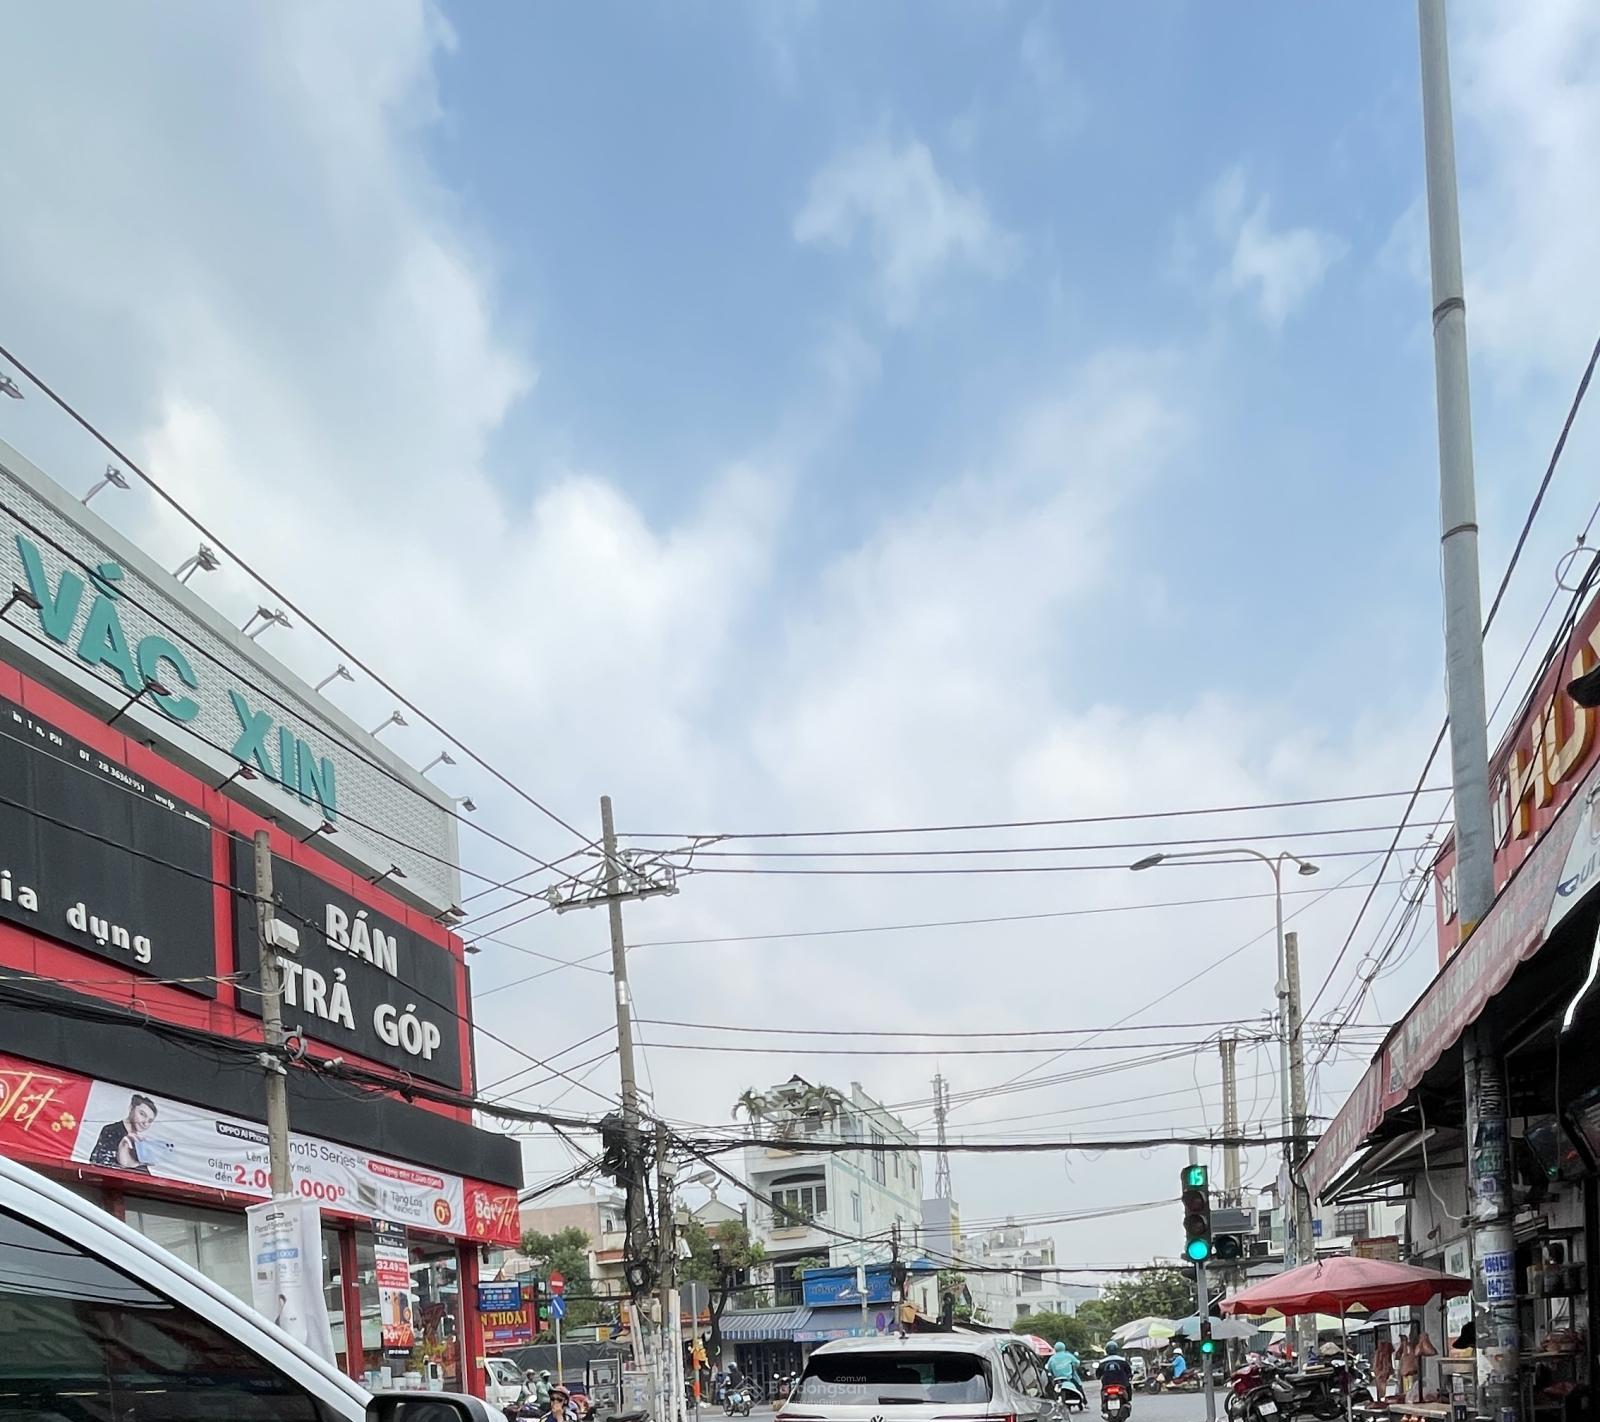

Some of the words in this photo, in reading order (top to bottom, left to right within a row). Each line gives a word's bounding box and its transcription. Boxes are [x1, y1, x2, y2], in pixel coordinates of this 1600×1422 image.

[15, 535, 200, 721] VÁC
[228, 688, 336, 822] XIN
[0, 870, 39, 912] ia
[66, 902, 153, 964] dụng
[325, 903, 398, 977] BÁN
[275, 956, 355, 1031] TRẢ
[373, 1003, 441, 1061] GÓP
[219, 1123, 240, 1136] OPPO
[290, 1141, 318, 1159] no15
[320, 1146, 356, 1169] Series
[1190, 1167, 1204, 1186] 15
[490, 1310, 528, 1328] THOẠI
